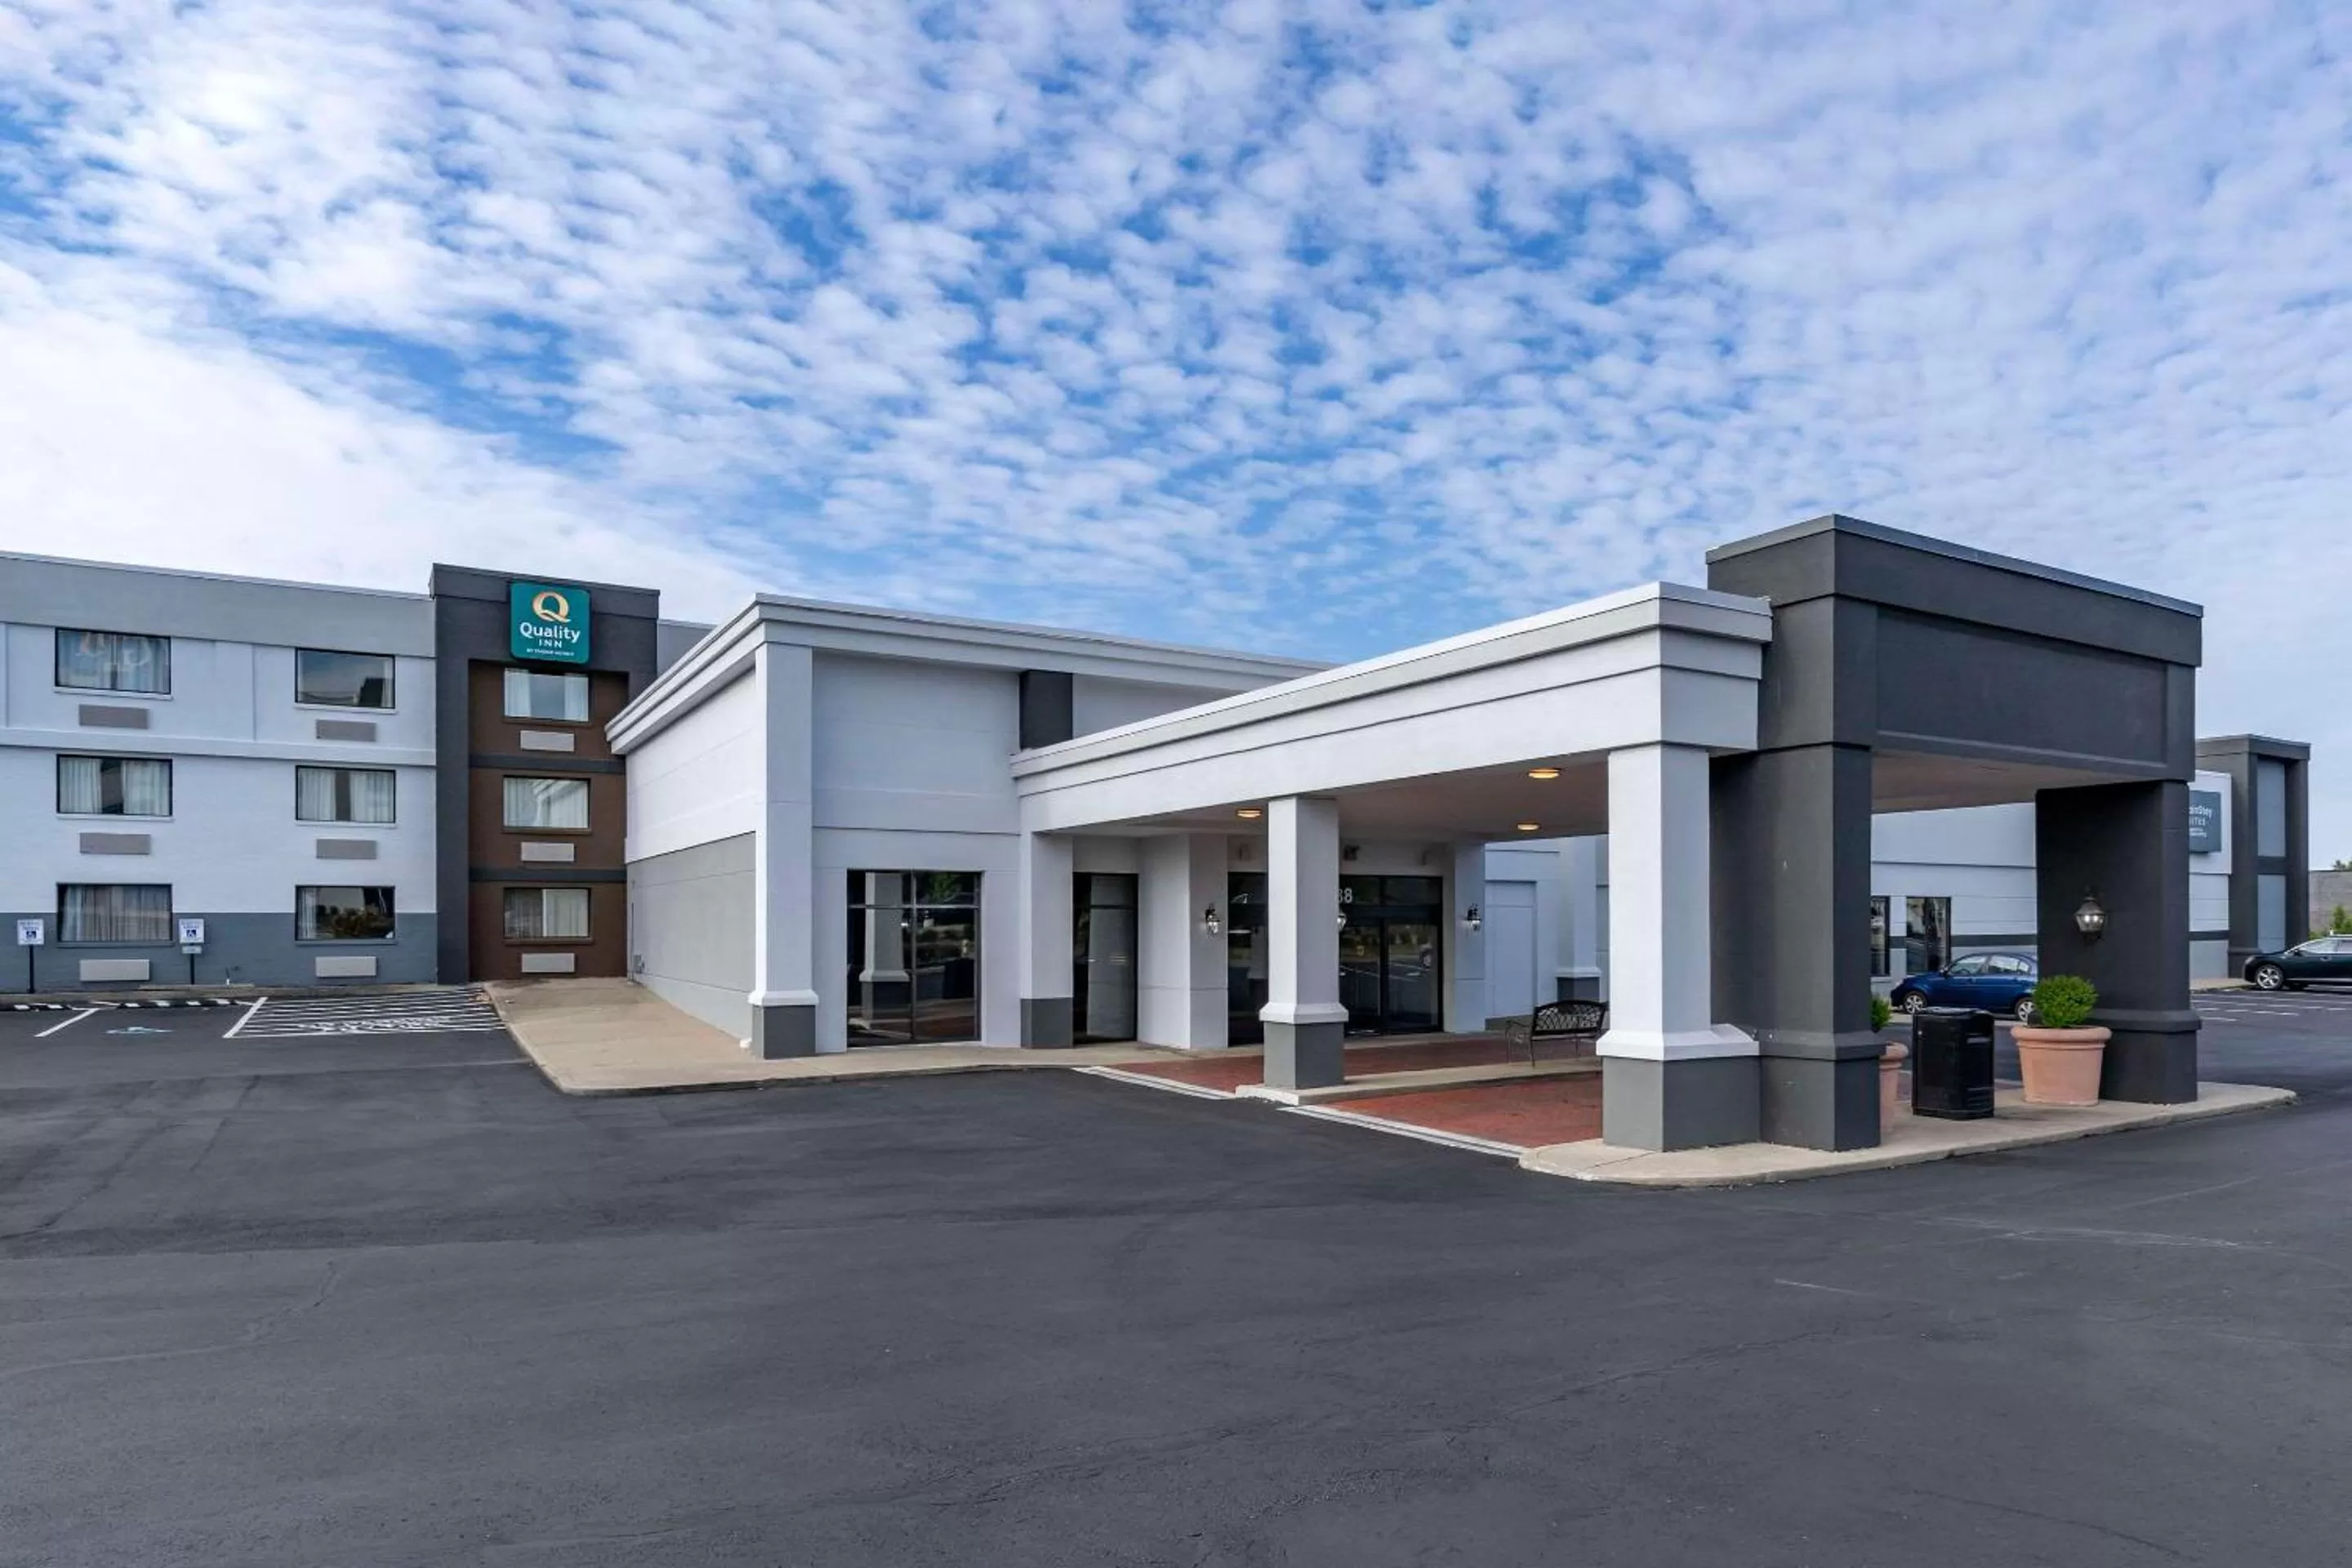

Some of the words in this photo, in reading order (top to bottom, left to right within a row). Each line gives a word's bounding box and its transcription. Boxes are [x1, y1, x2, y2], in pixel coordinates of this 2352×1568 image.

[532, 591, 571, 622] Q
[519, 621, 581, 644] Quality
[538, 638, 562, 648] INN
